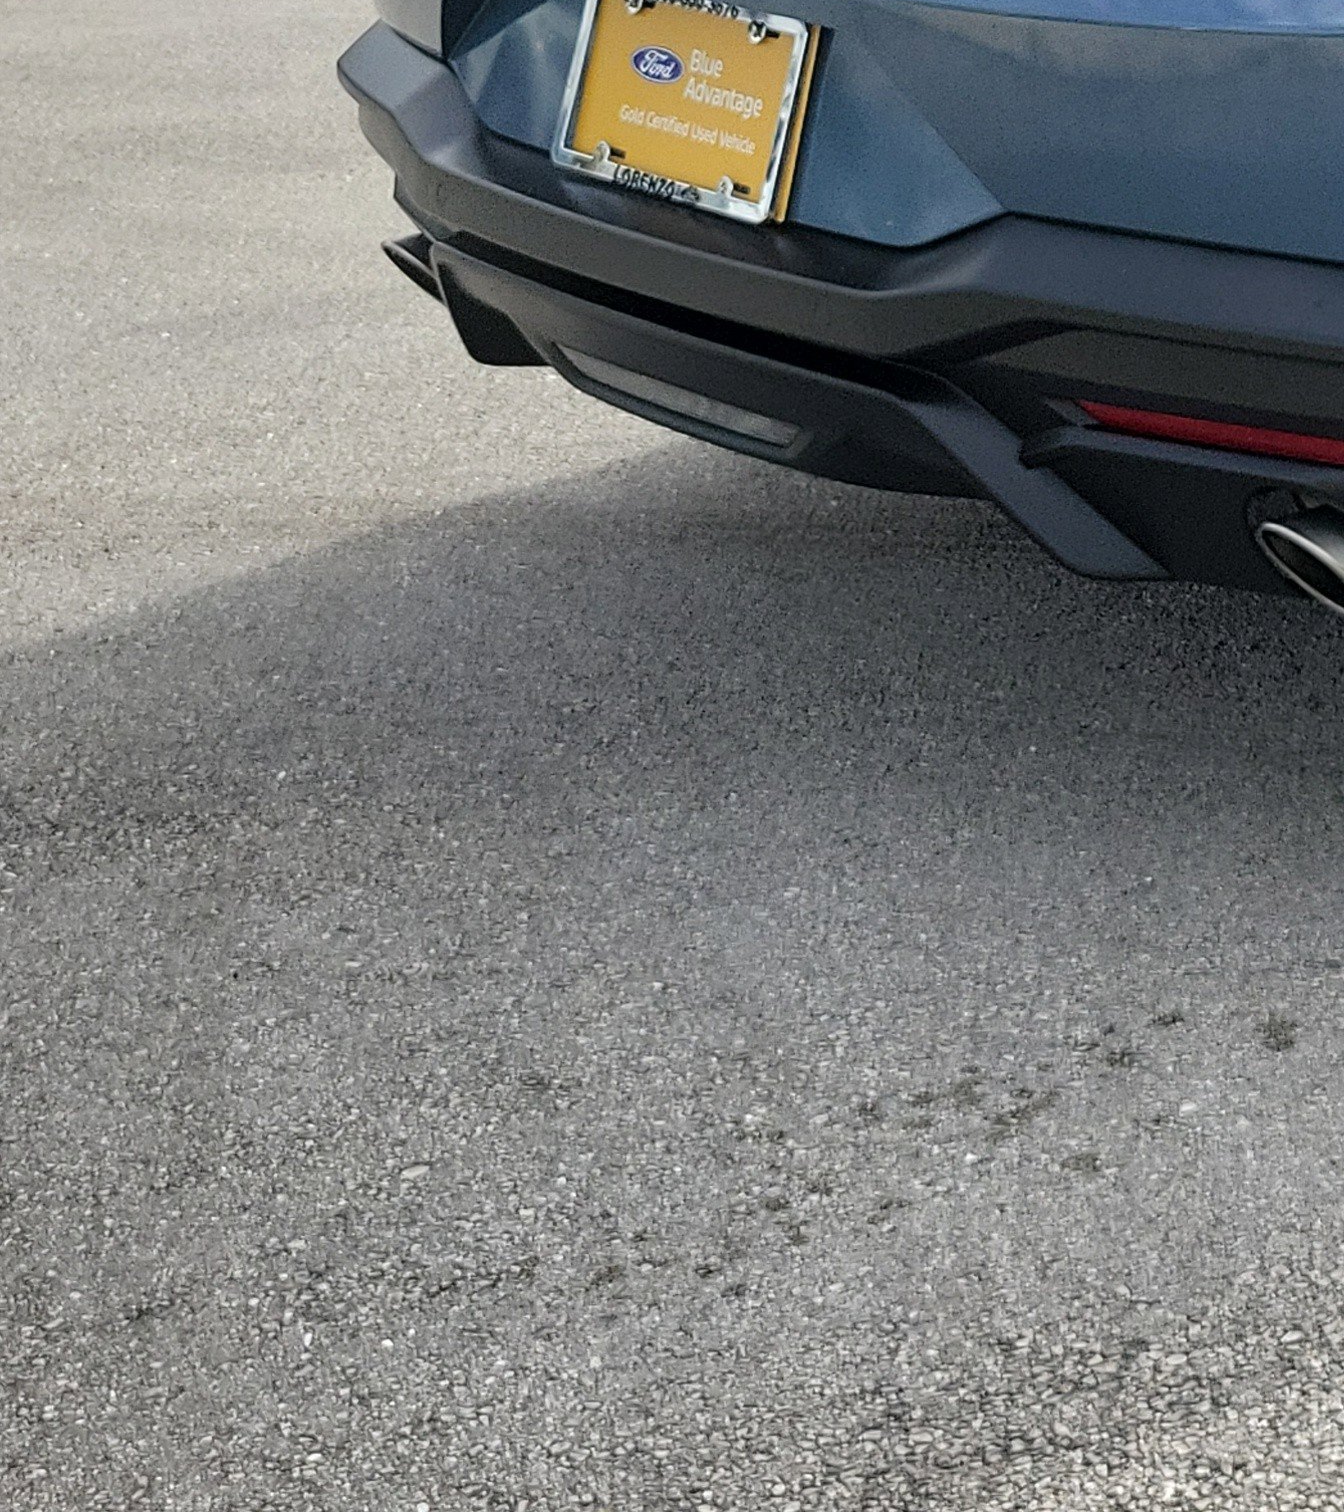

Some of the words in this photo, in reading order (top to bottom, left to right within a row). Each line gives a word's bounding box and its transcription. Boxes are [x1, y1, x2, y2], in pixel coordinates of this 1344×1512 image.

[639, 49, 676, 79] Ford
[690, 48, 724, 78] Blue
[683, 76, 763, 120] Advantage
[619, 103, 645, 126] Gold
[645, 110, 690, 138] Certified
[690, 122, 719, 145] Used
[719, 129, 757, 157] Vehicle
[611, 164, 677, 200] LORENZO
